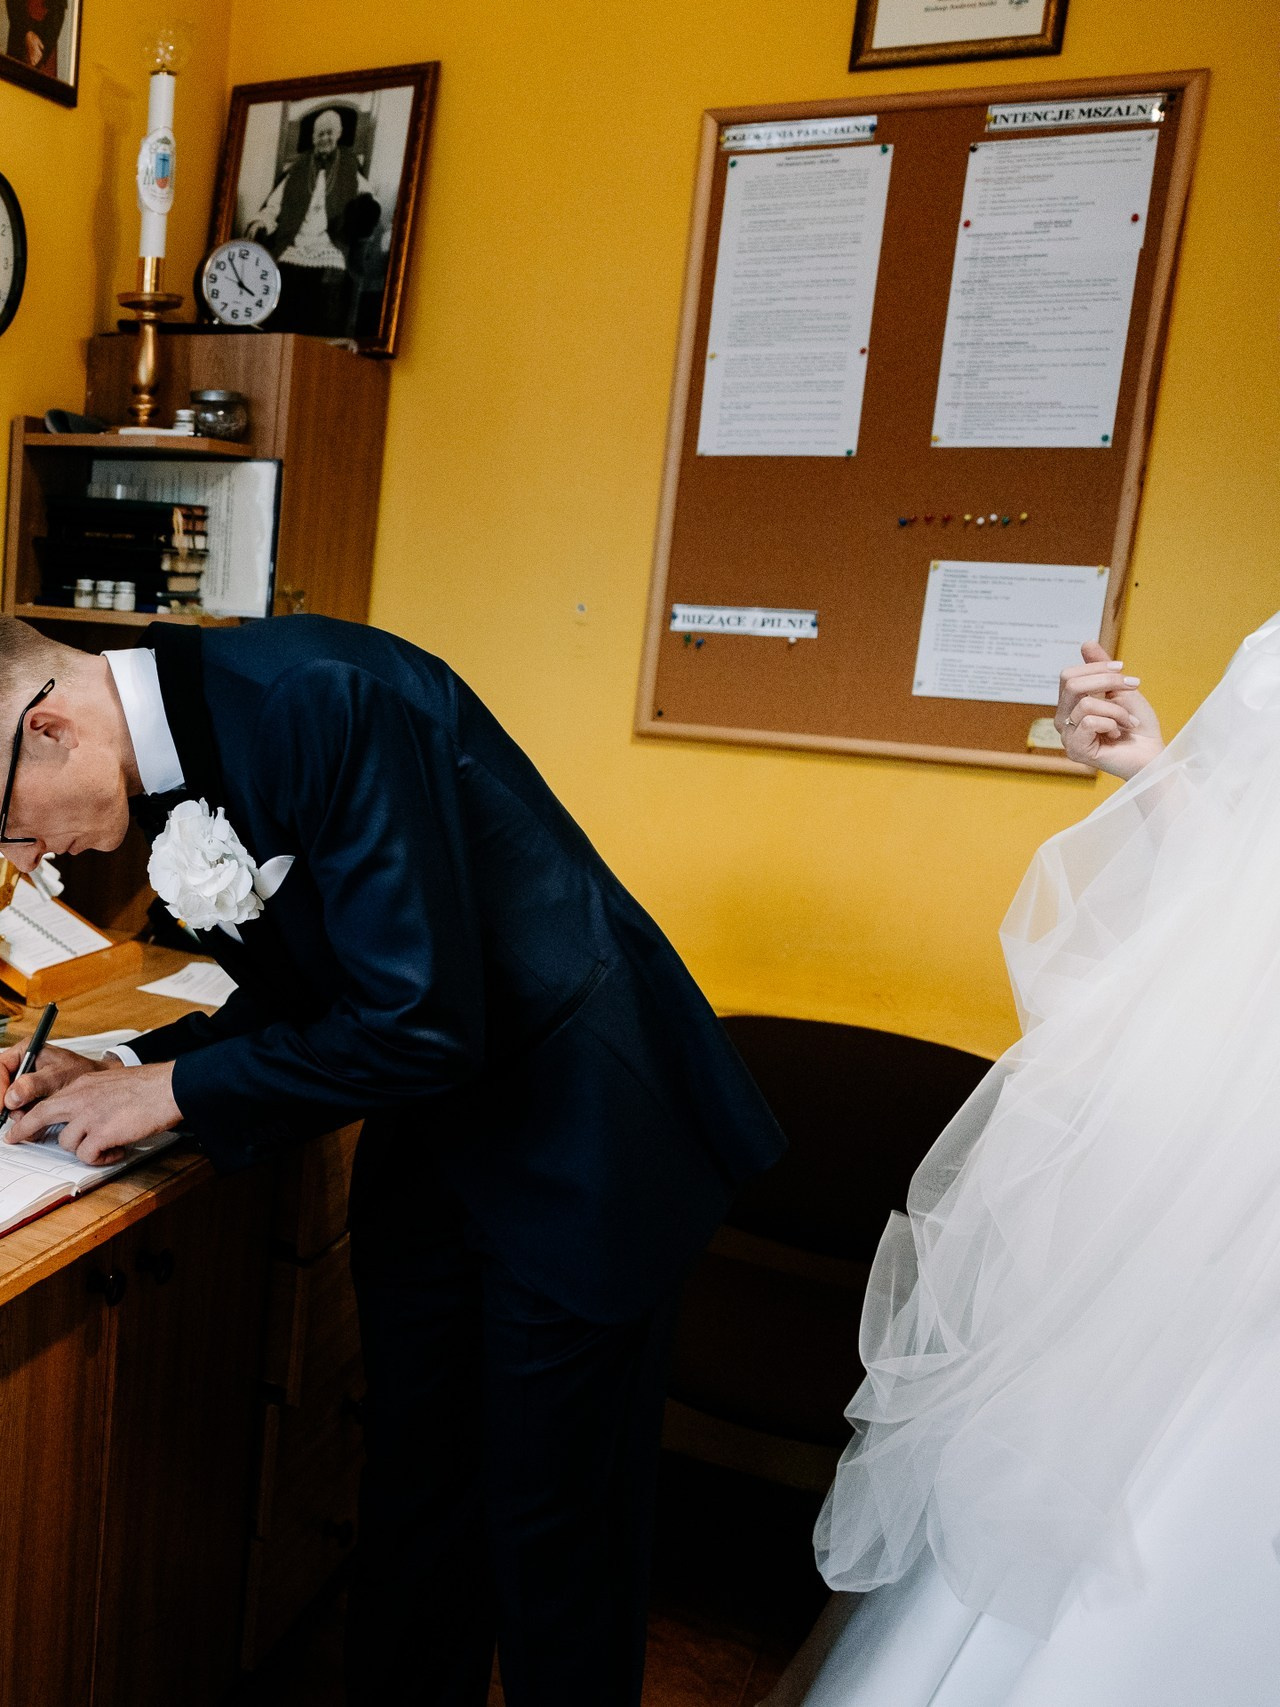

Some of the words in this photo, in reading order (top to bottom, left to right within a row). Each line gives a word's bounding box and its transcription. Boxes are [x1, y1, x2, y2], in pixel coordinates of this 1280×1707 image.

[992, 108, 1076, 125] INTENCJE
[1, 223, 6, 237] 2
[3, 257, 8, 270] 3
[215, 260, 226, 271] 10
[256, 257, 260, 266] 1
[209, 273, 217, 283] 9
[260, 270, 268, 280] 2
[211, 288, 219, 299] 8
[263, 284, 270, 295] 3
[220, 302, 228, 311] 7
[255, 298, 263, 308] 4
[231, 309, 239, 319] 6
[244, 307, 252, 318] 5
[682, 612, 746, 628] BIEŻĄCE
[761, 616, 808, 630] PILNE
